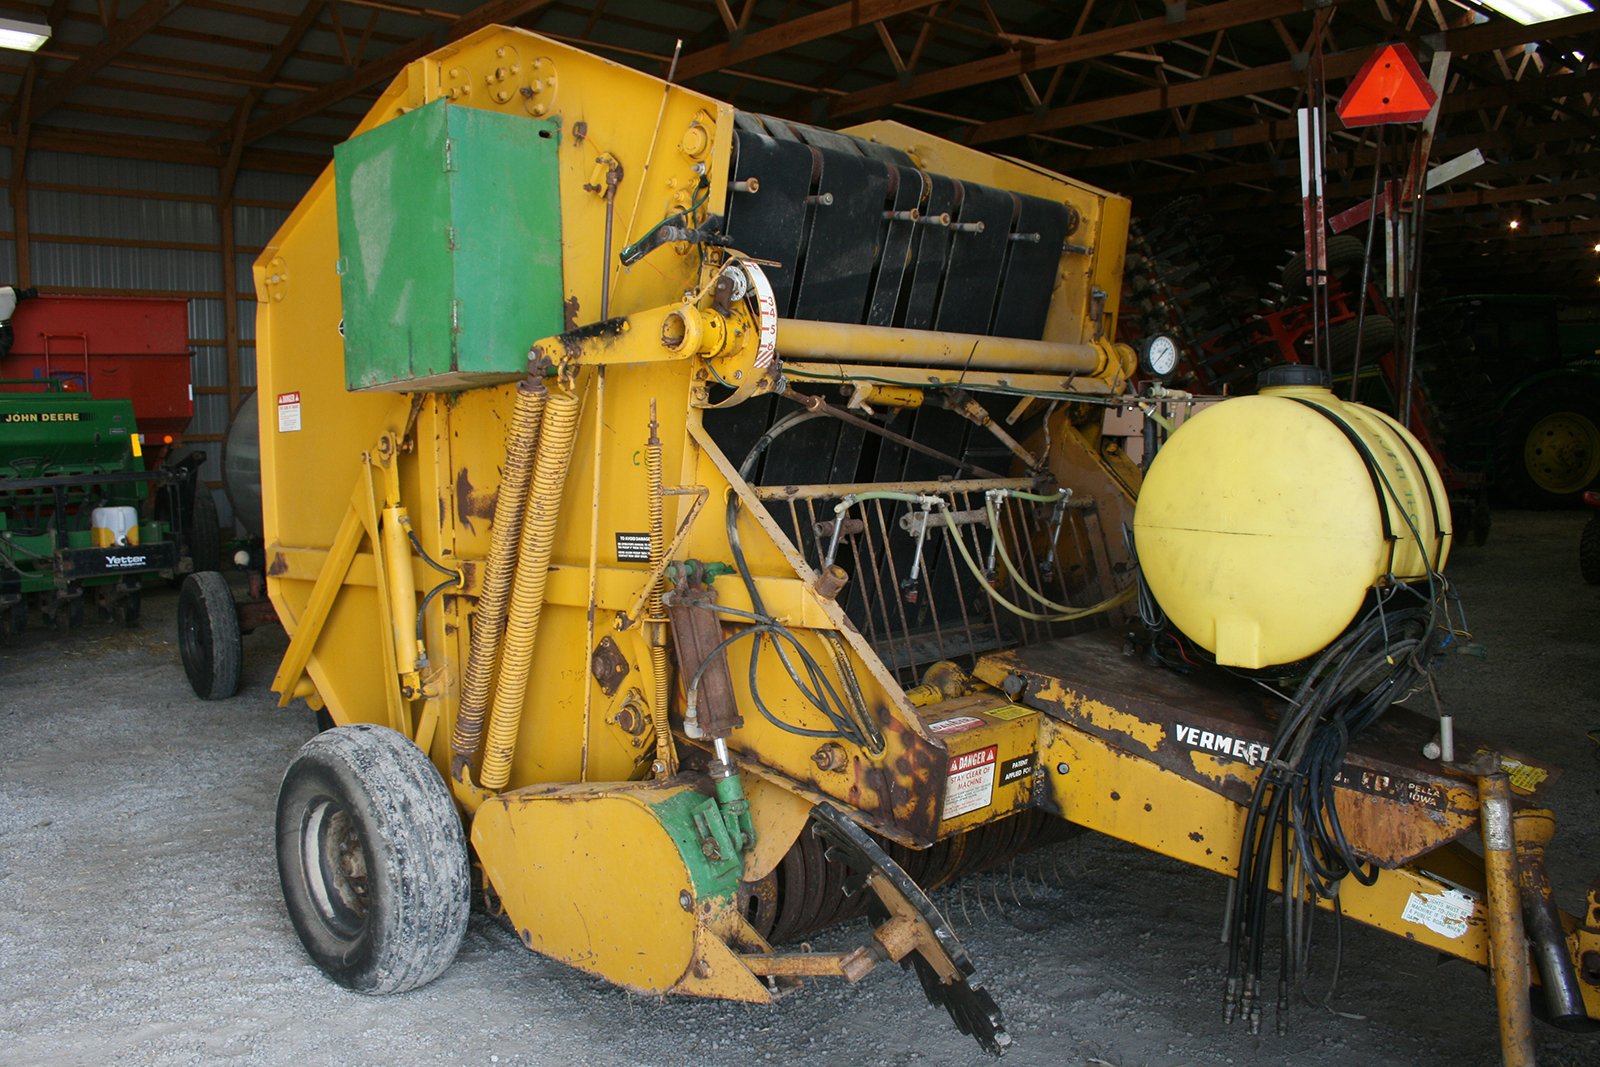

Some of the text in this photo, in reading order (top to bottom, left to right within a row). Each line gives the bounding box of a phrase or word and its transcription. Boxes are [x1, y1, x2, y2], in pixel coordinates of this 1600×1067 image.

[768, 296, 774, 307] 3
[769, 308, 776, 318] 4
[769, 324, 776, 335] 5
[767, 341, 774, 352] 6
[5, 412, 80, 423] JOHN DEERE
[105, 554, 146, 564] Yetter
[958, 751, 987, 770] DANGER
[950, 766, 990, 785] STAY CLEAR OF
[958, 777, 983, 790] MACHINE
[1408, 783, 1440, 798] PELLA
[1408, 792, 1437, 806] IOWA
